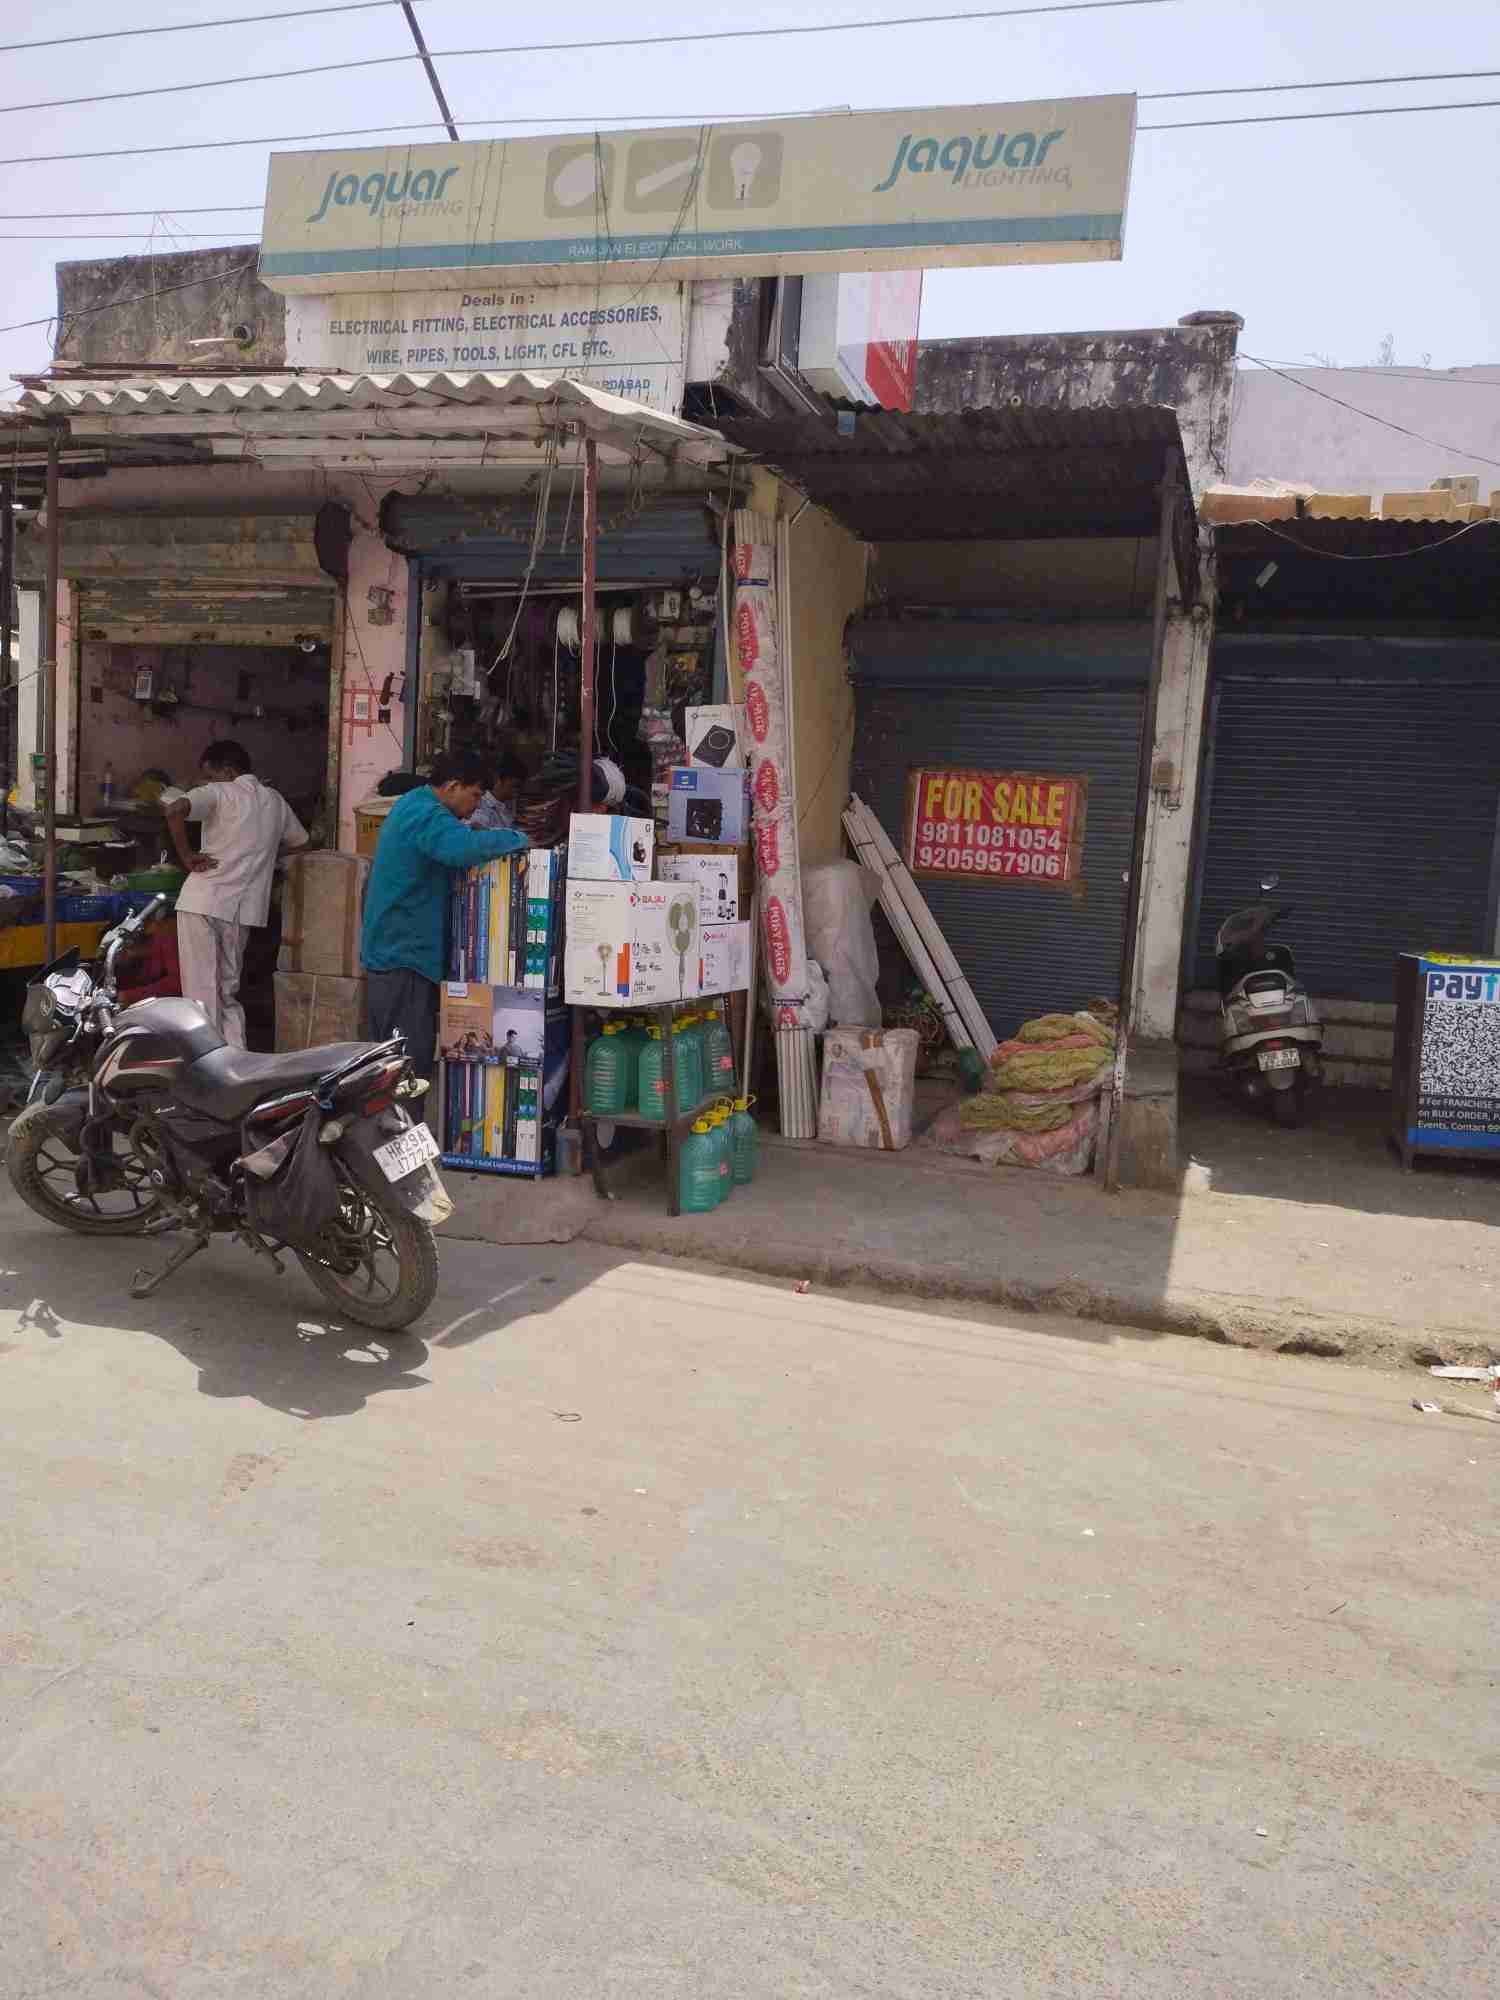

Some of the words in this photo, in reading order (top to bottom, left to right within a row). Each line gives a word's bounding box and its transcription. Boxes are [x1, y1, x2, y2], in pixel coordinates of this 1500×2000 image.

[962, 167, 1073, 189] LIGHTING
[461, 293, 505, 307] Deals
[510, 293, 526, 305] in
[329, 319, 409, 335] ELECTRICAL
[412, 317, 469, 334] FITTING,
[473, 313, 556, 331] ELECTRICAL
[560, 305, 663, 327] ACCESSORIES,
[367, 348, 402, 365] WIRE,
[407, 346, 449, 365] PIPES,
[453, 345, 500, 362] TOOLS,
[504, 343, 547, 360] LIGHT,
[552, 343, 578, 357] CFL
[926, 778, 983, 820] FOR
[991, 782, 1065, 826] SALE
[922, 821, 1061, 850] 9811081054
[919, 848, 1060, 875] 9205957906
